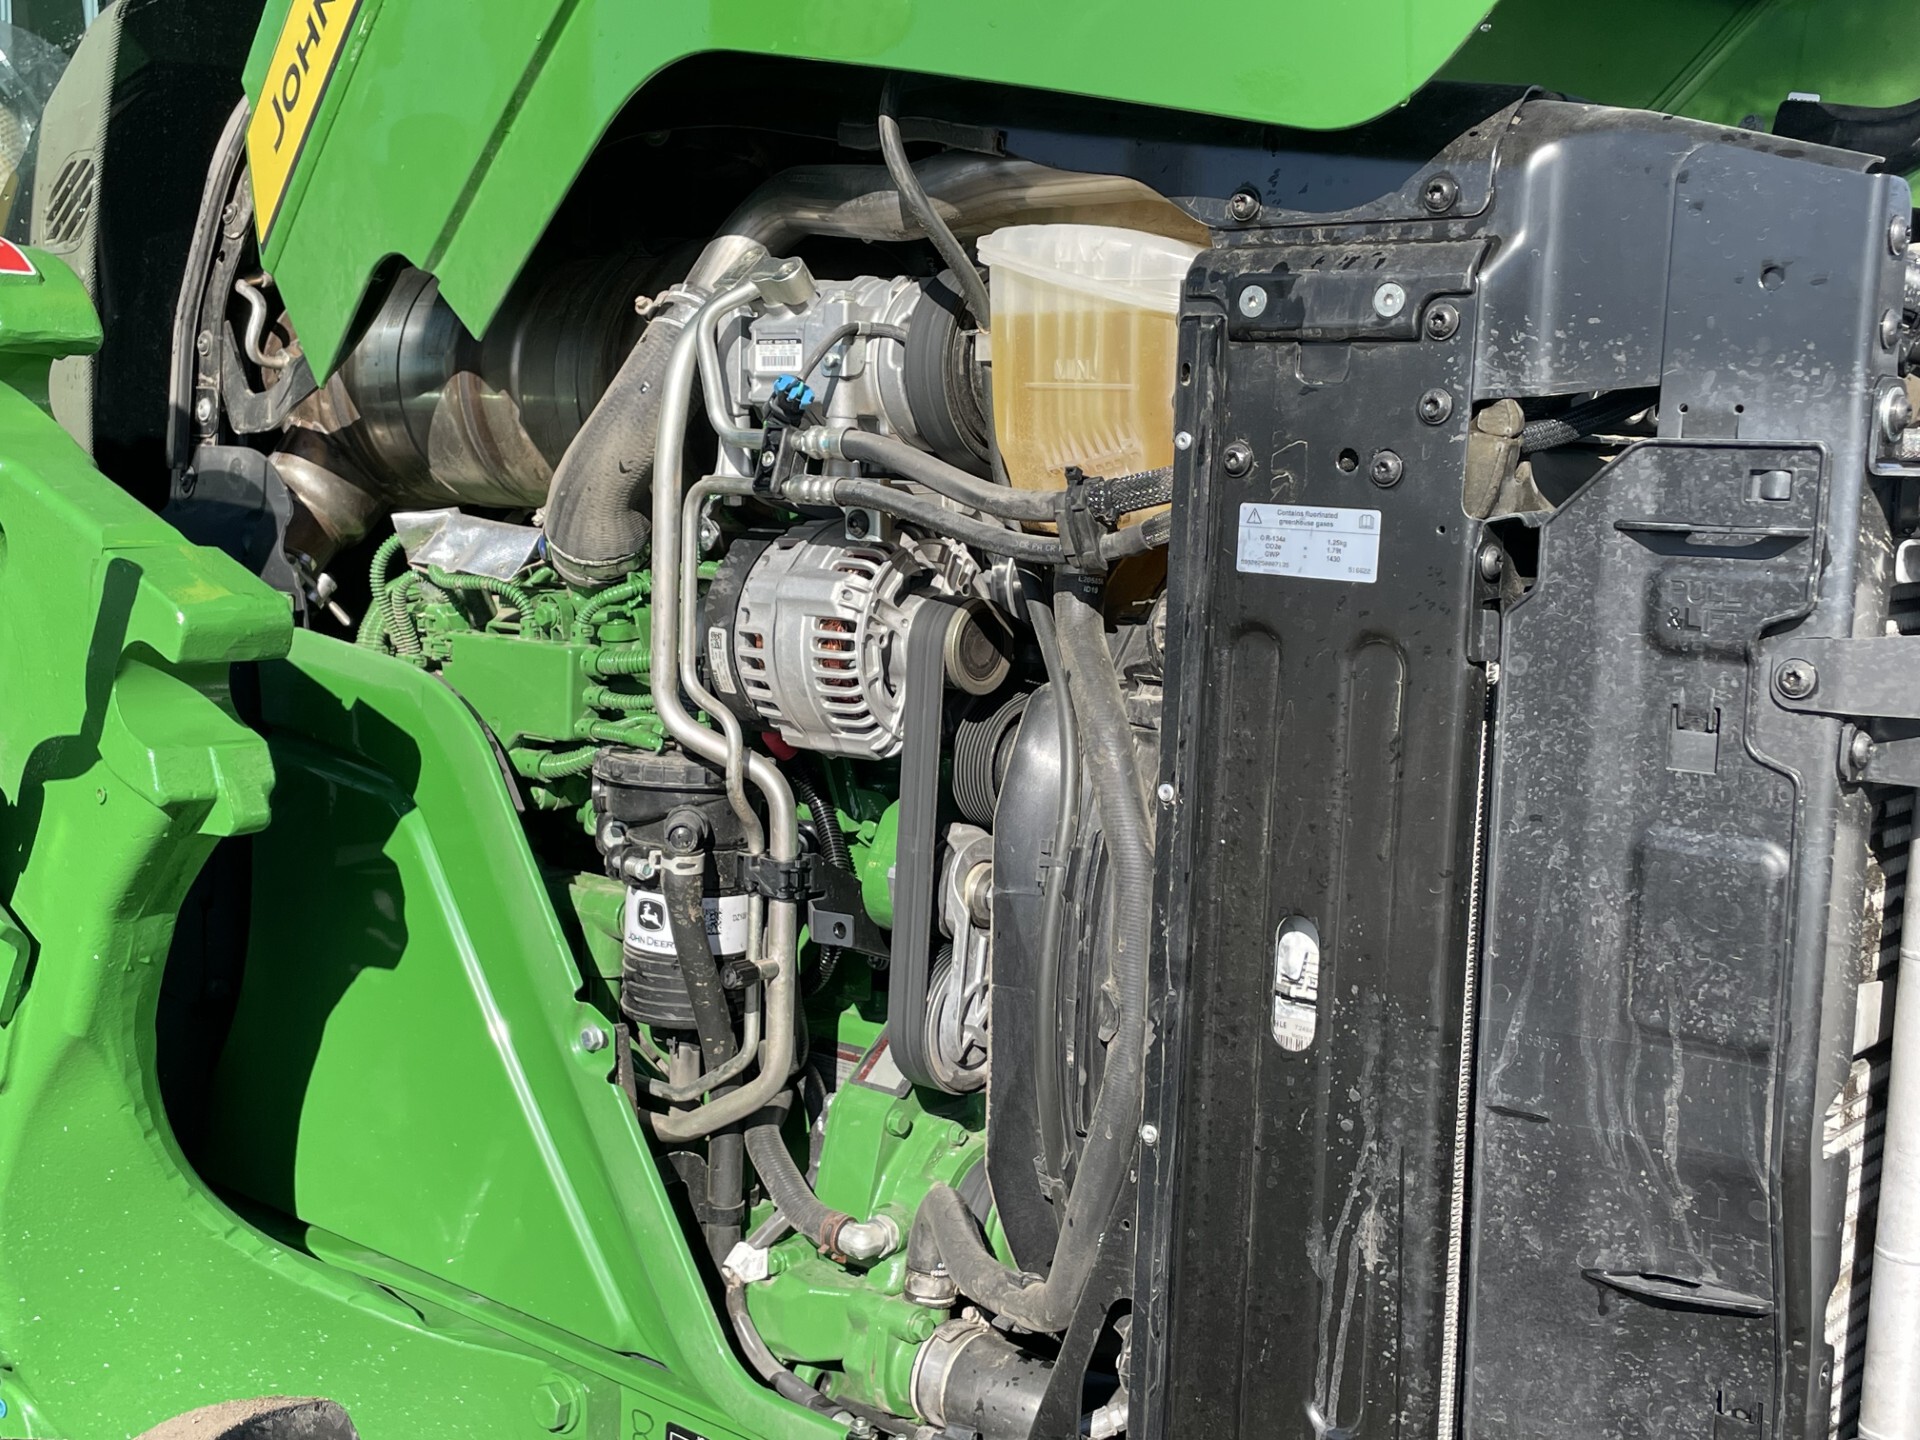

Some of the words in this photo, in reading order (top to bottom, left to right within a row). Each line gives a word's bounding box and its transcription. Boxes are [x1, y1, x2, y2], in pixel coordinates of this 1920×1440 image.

[1277, 508, 1304, 517] Contains
[1305, 510, 1338, 519] fluorinated
[1279, 518, 1314, 527] greenhouse
[646, 936, 675, 949] DEER
